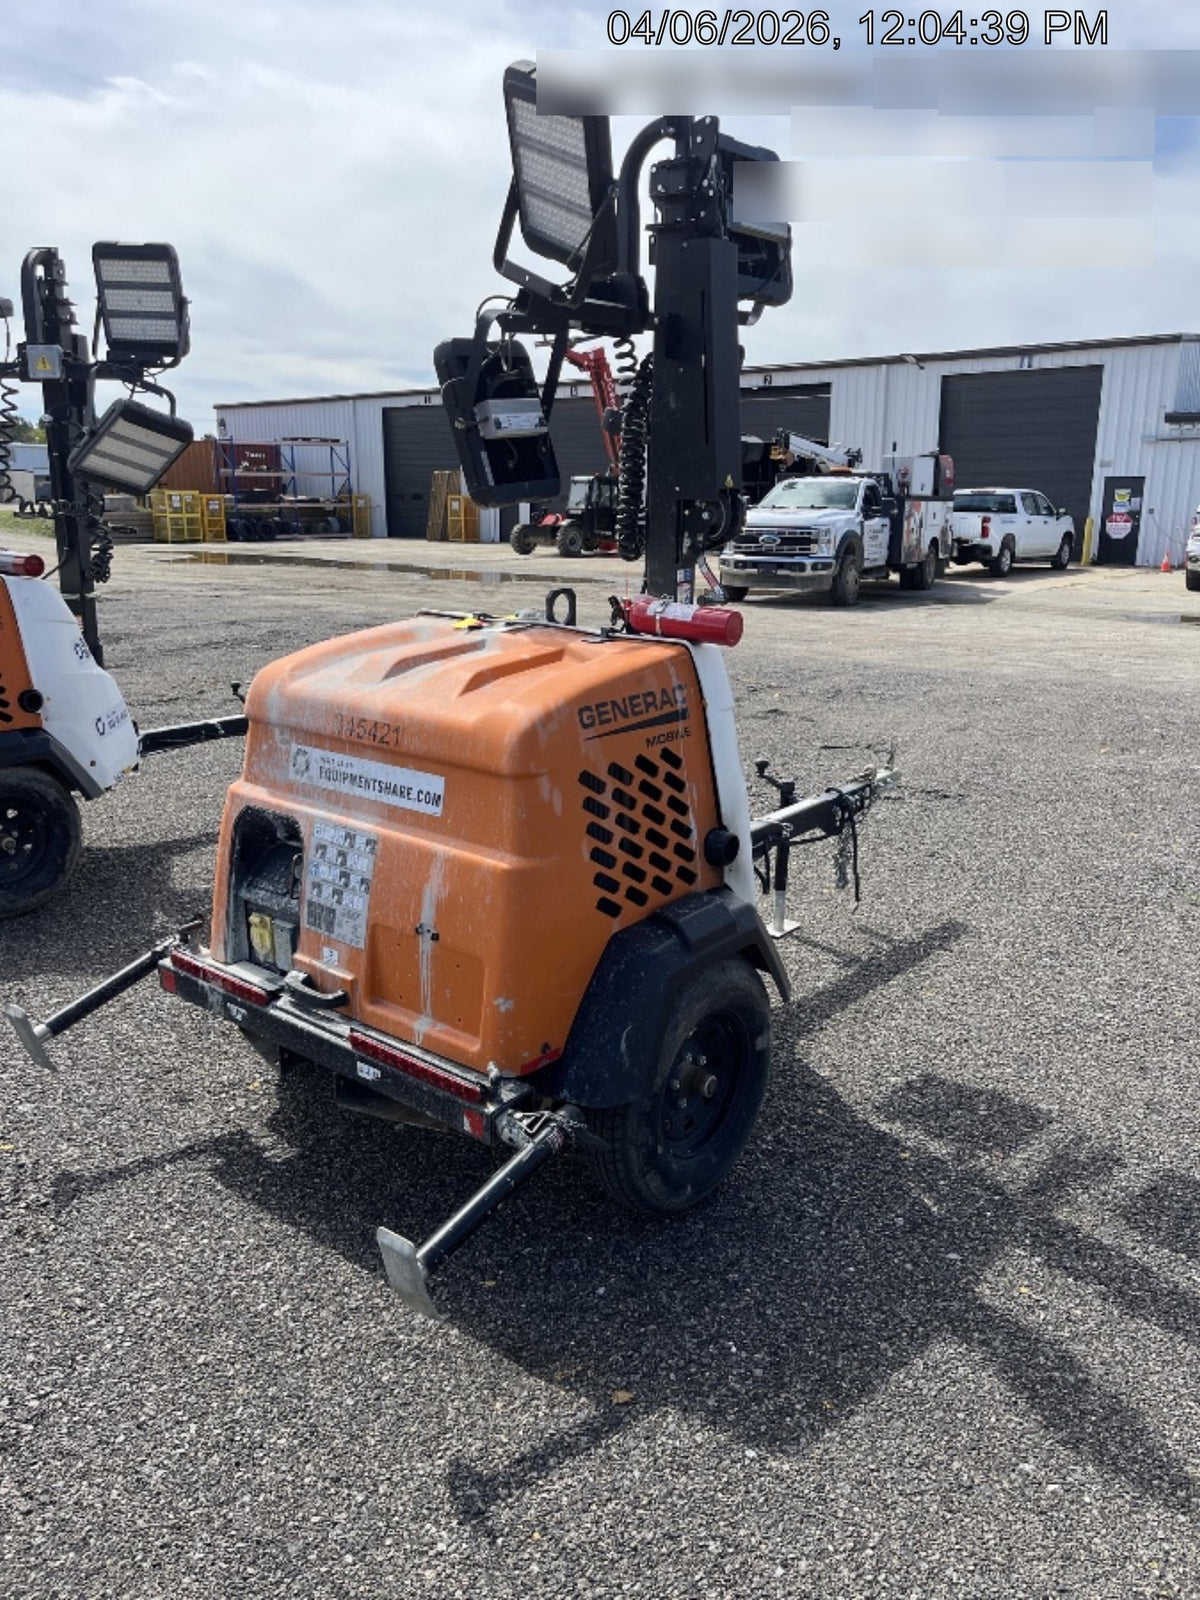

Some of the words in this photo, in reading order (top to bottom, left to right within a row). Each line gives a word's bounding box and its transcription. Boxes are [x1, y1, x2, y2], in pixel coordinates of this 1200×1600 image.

[577, 684, 688, 730] GENERAC
[645, 727, 692, 748] MOBILE
[318, 764, 442, 808] EQUIPMENTSHARE.COM
